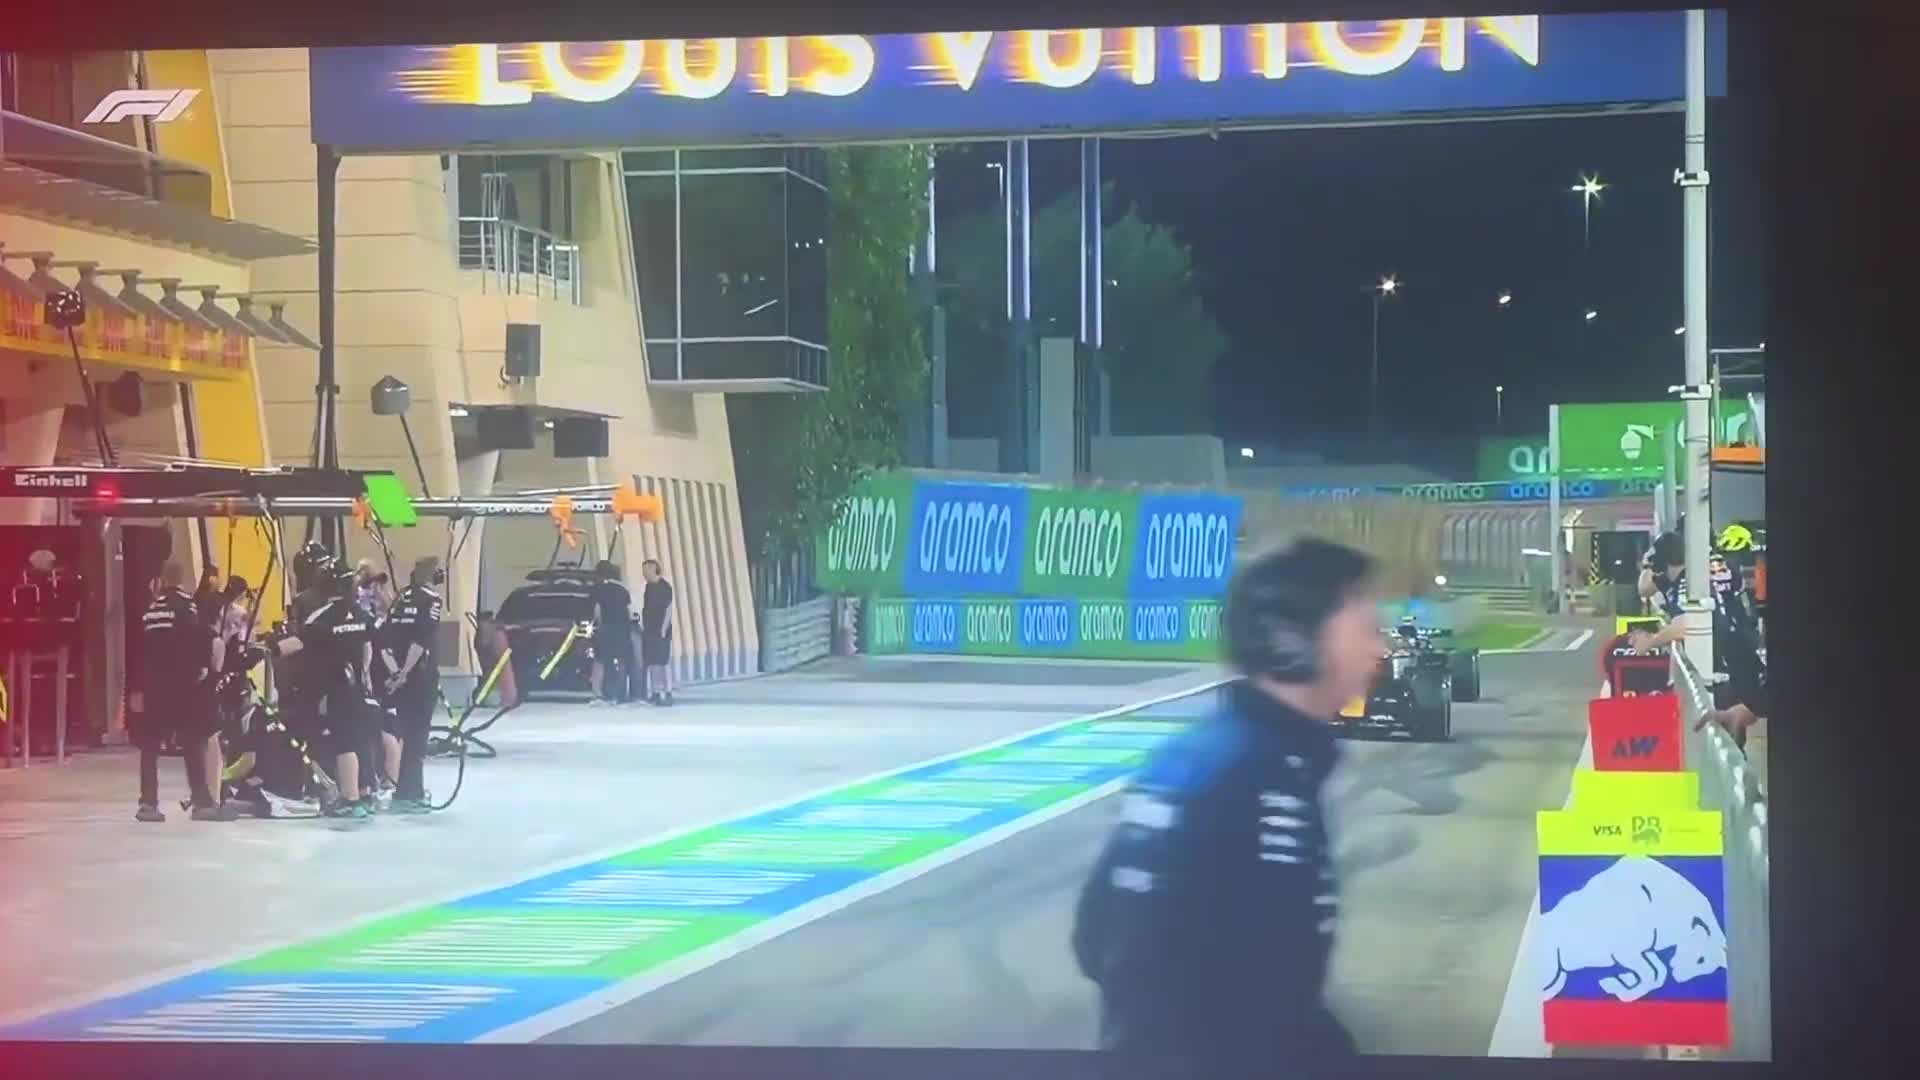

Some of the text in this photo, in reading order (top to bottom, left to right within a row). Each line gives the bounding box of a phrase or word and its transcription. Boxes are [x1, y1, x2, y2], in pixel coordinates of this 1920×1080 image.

[472, 33, 876, 105] LOUIS
[15, 473, 88, 487] Einhell
[1401, 483, 1486, 500] aramco
[1510, 479, 1595, 498] araco
[919, 500, 1012, 574] aramco
[1033, 505, 1123, 578] aramco
[1145, 511, 1230, 579] aramco
[913, 604, 956, 642] aramco
[967, 604, 1012, 642] aramco
[1023, 604, 1069, 642] aramco
[1080, 605, 1125, 641] aramco
[1135, 605, 1180, 641] aramco
[1592, 824, 1623, 836] VISA
